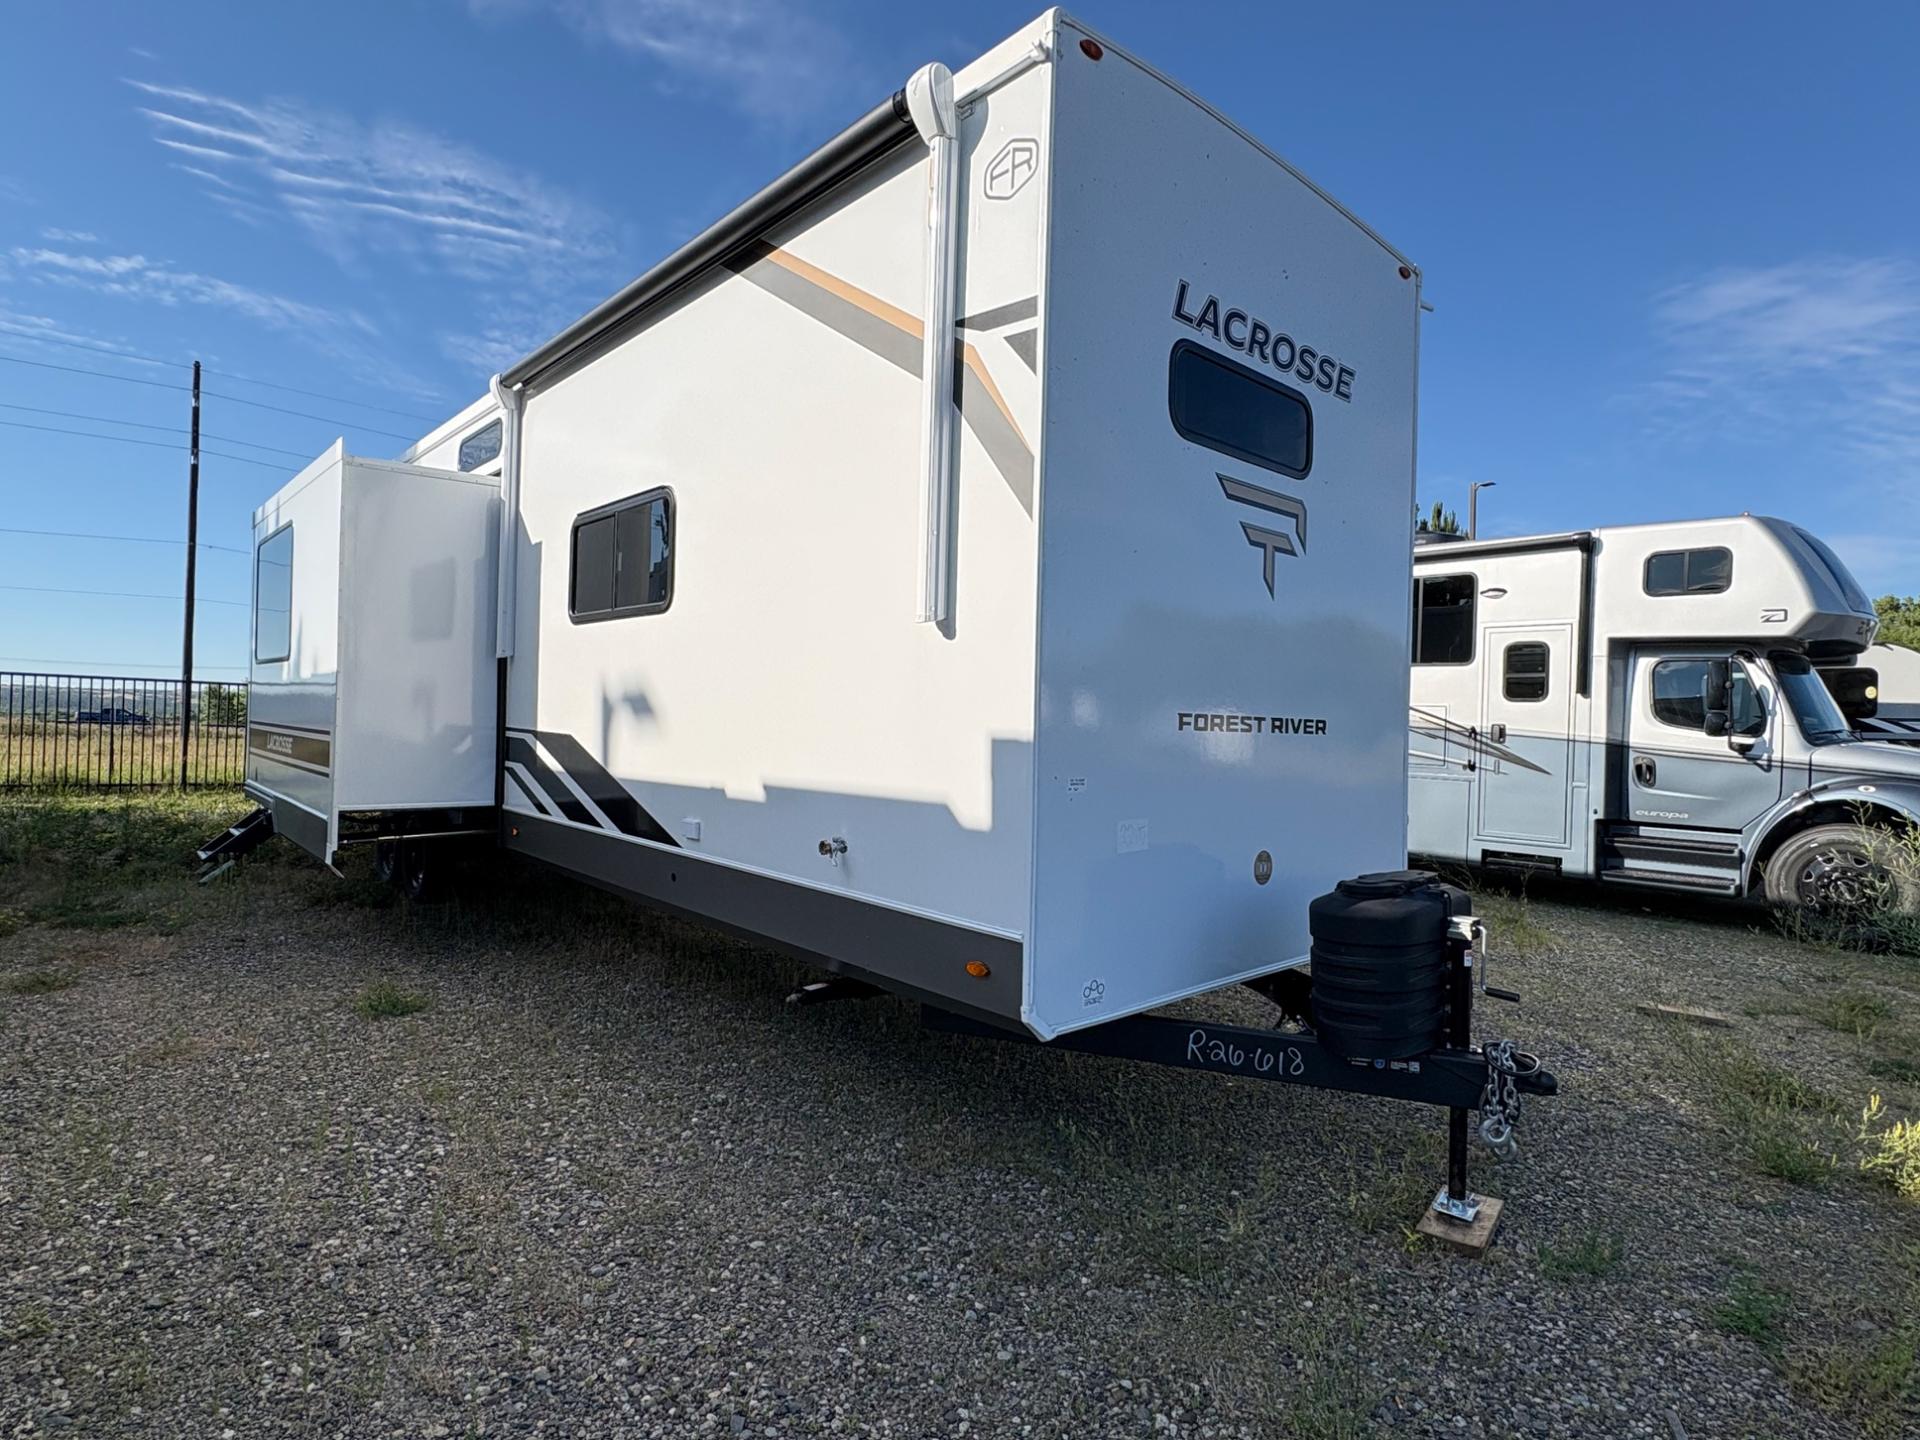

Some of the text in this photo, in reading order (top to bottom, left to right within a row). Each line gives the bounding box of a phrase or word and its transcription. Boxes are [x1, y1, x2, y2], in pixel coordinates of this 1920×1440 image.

[1172, 279, 1356, 403] LACROSSE
[1178, 713, 1326, 735] FOREST RIVER
[267, 733, 293, 754] LACROSSE
[1635, 810, 1688, 819] europa
